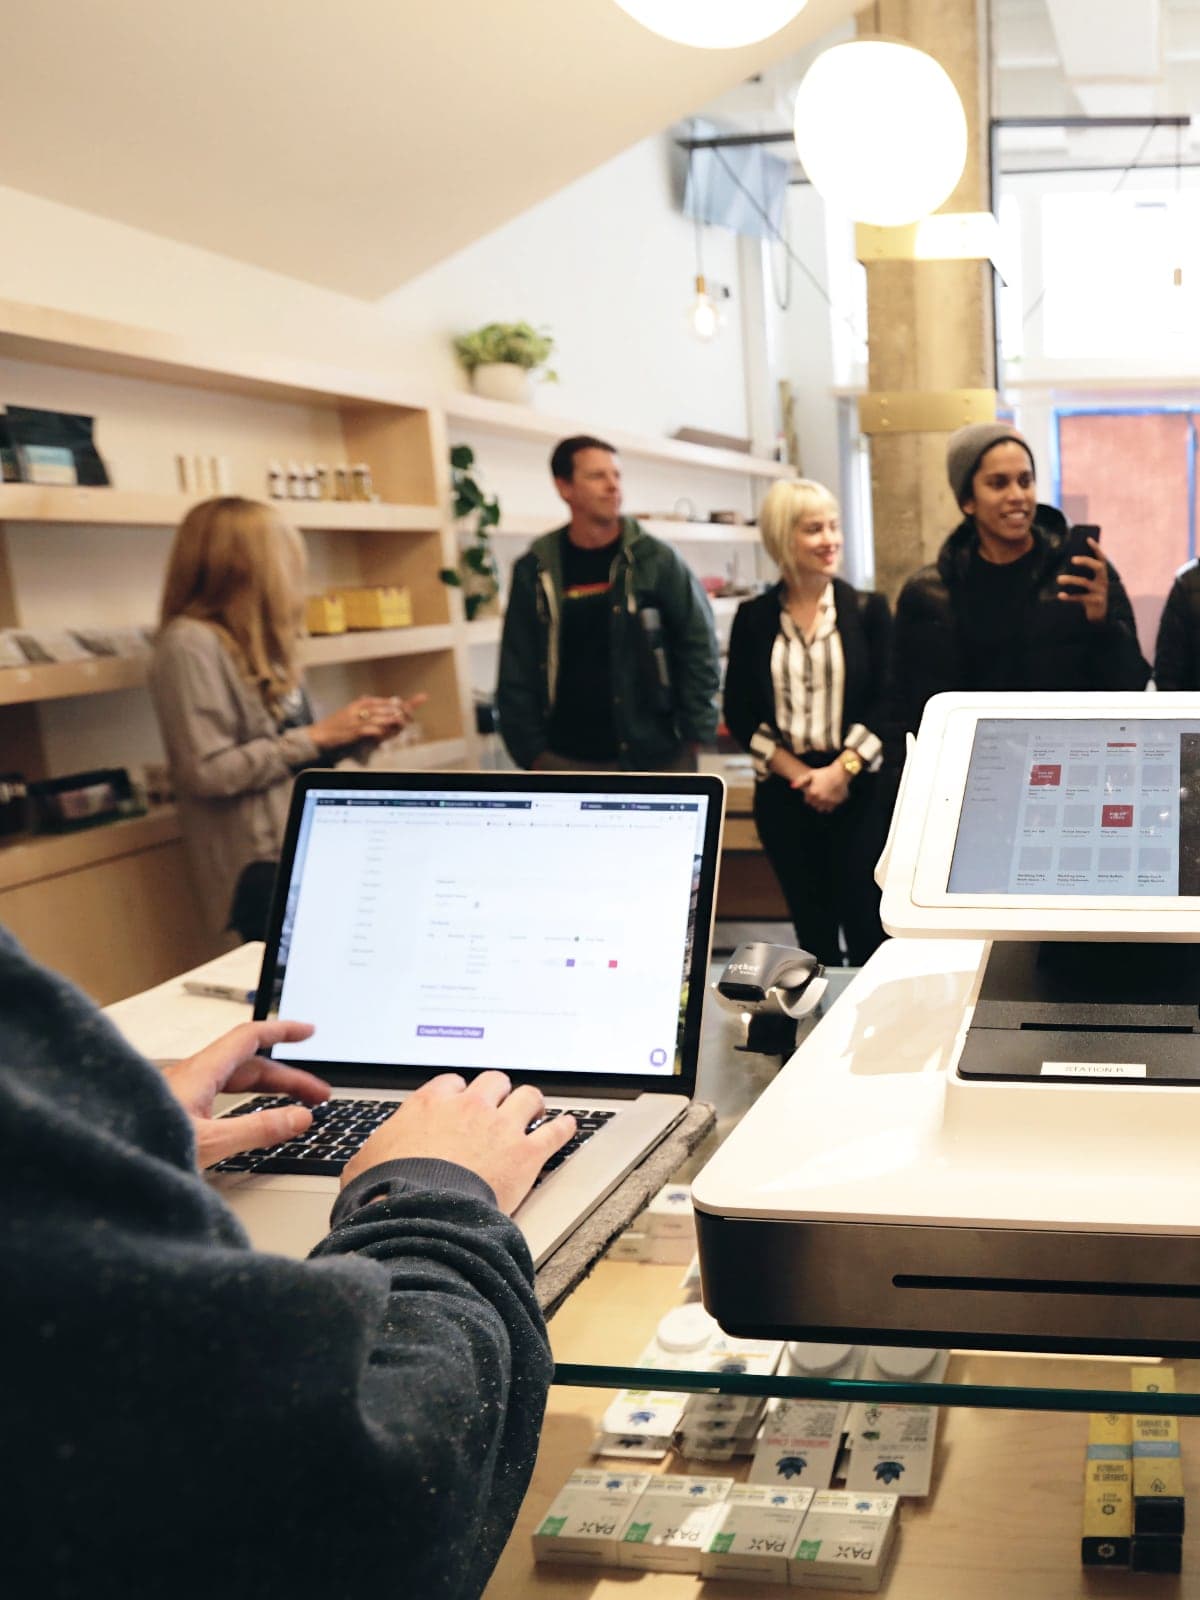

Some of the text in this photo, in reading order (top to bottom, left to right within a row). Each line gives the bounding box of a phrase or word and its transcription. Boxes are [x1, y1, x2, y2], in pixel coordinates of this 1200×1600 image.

[1064, 1065, 1112, 1073] STATION
[577, 1521, 616, 1535] PAX
[664, 1527, 700, 1541] PAX
[747, 1538, 786, 1552] PAX
[834, 1544, 873, 1560] PAX
